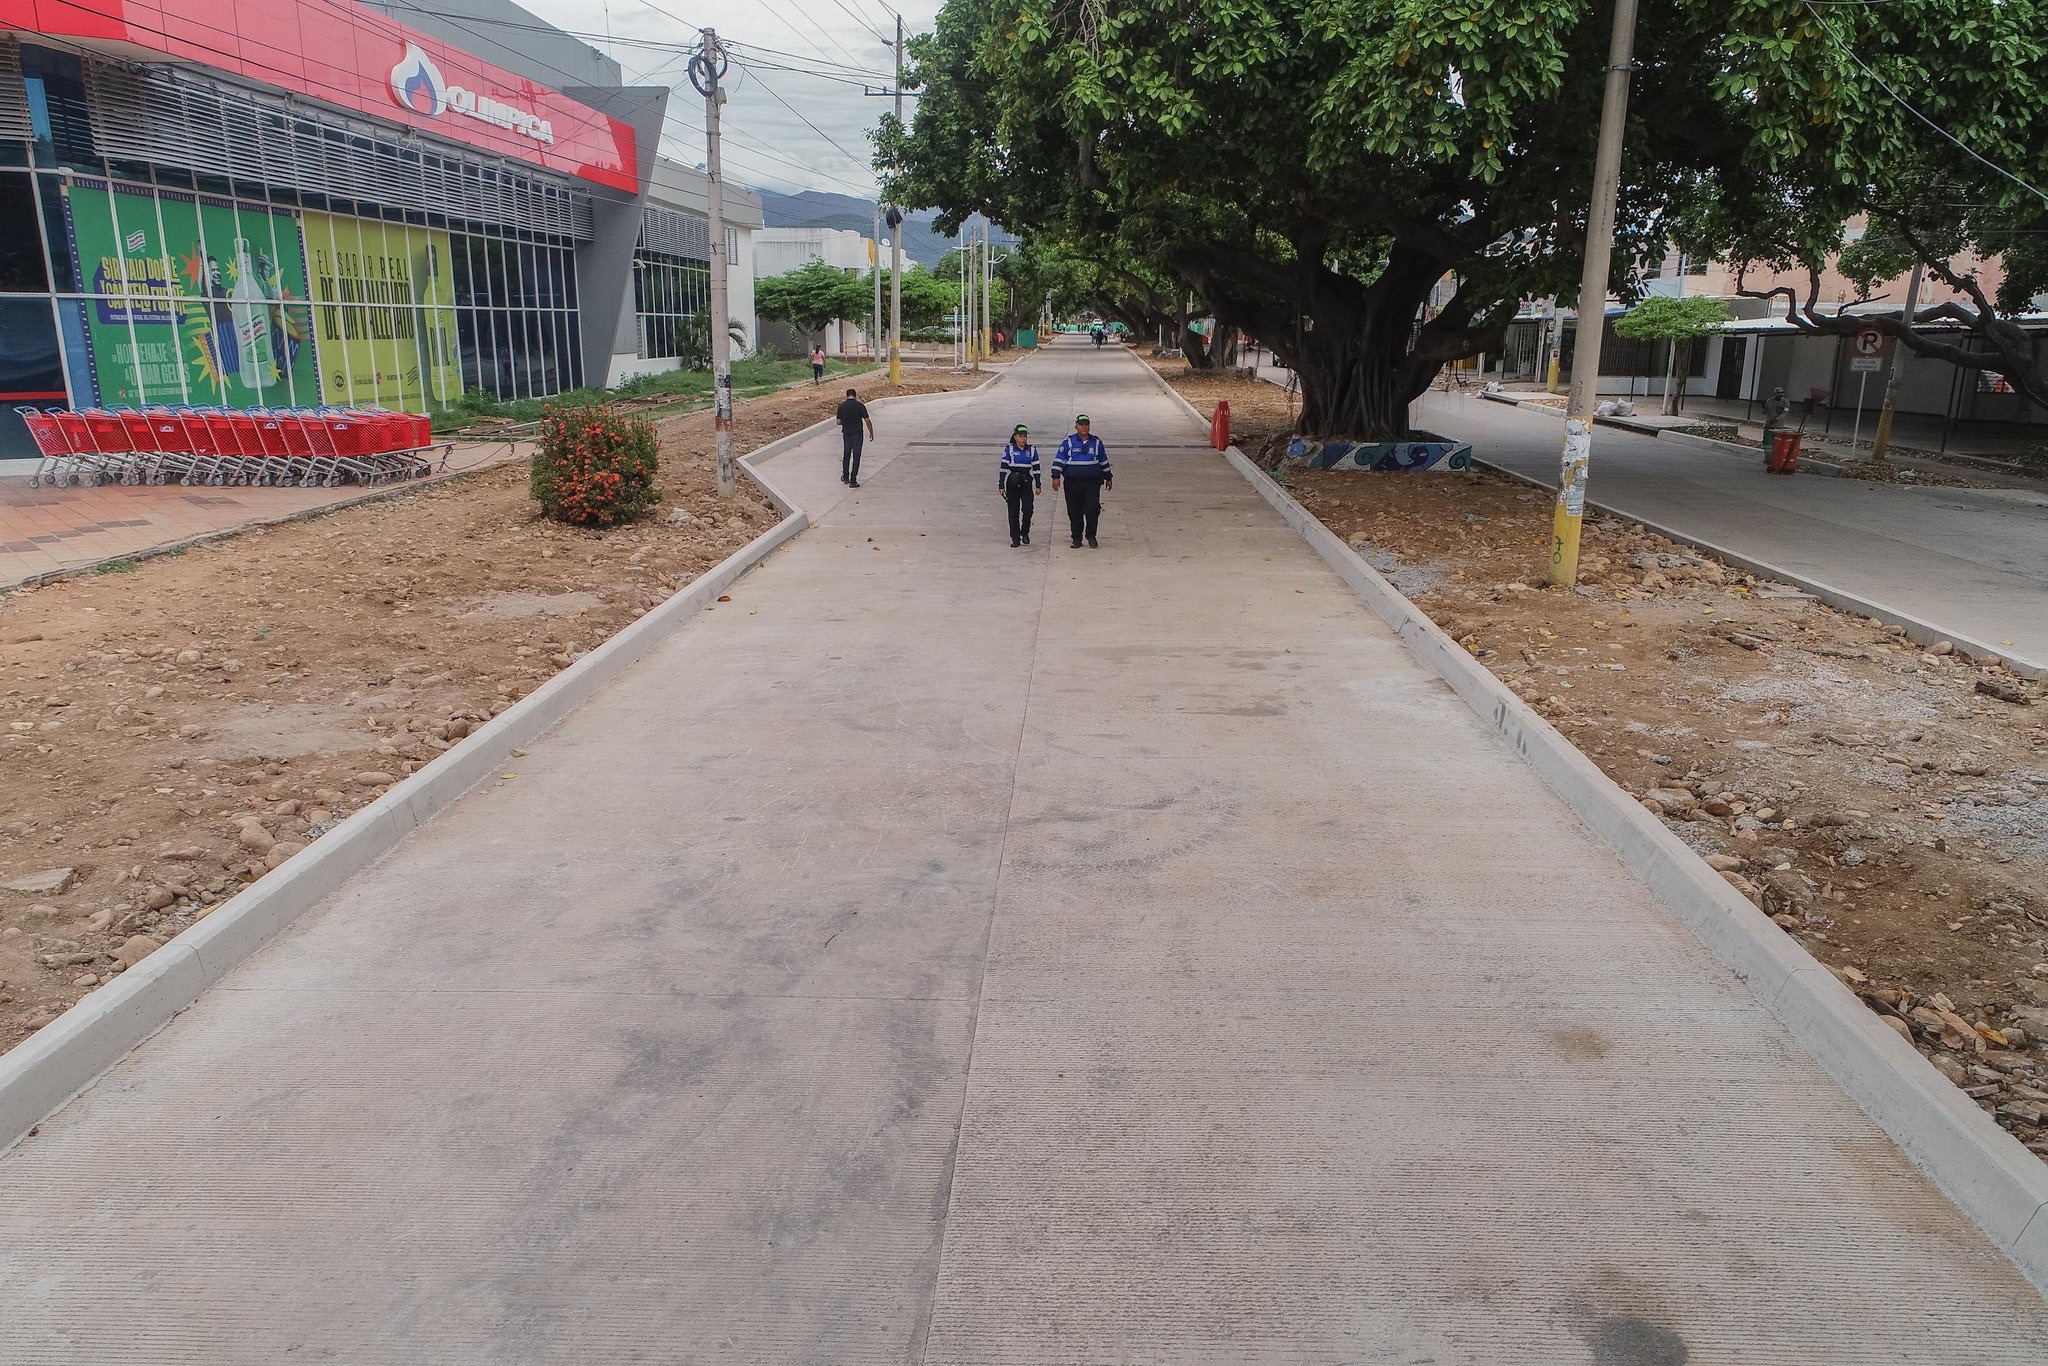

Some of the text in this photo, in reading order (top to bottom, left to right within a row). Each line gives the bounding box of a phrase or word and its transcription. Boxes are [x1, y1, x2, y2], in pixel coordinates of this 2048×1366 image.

[317, 249, 330, 276] EL
[379, 256, 409, 282] REAL
[320, 276, 340, 341] DE
[338, 278, 359, 341] UN
[115, 342, 169, 364] HOMENAJE
